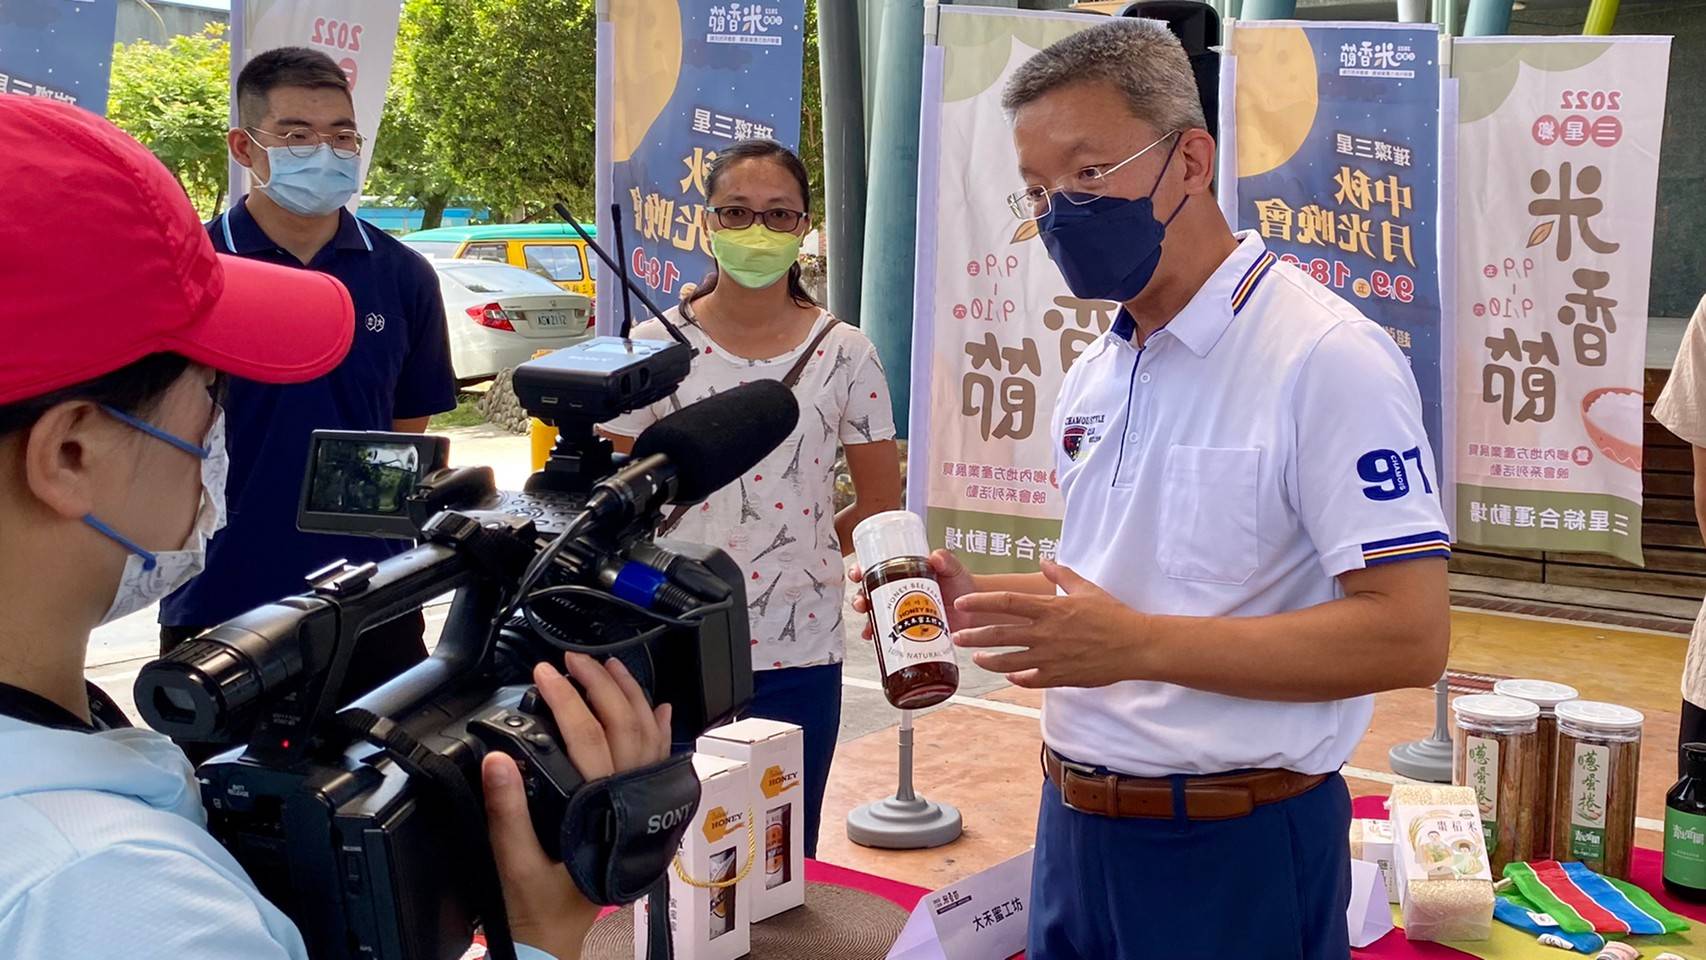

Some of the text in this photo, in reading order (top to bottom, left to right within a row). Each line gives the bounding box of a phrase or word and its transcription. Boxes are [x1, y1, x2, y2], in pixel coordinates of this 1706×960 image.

[1356, 446, 1433, 501] 97
[887, 585, 909, 609] HONEY
[899, 607, 924, 619] HONEY
[768, 771, 798, 787] HONEY
[647, 801, 693, 834] SONY
[711, 812, 744, 830] HONEY
[972, 896, 1024, 932] 大禾蜜工坊
